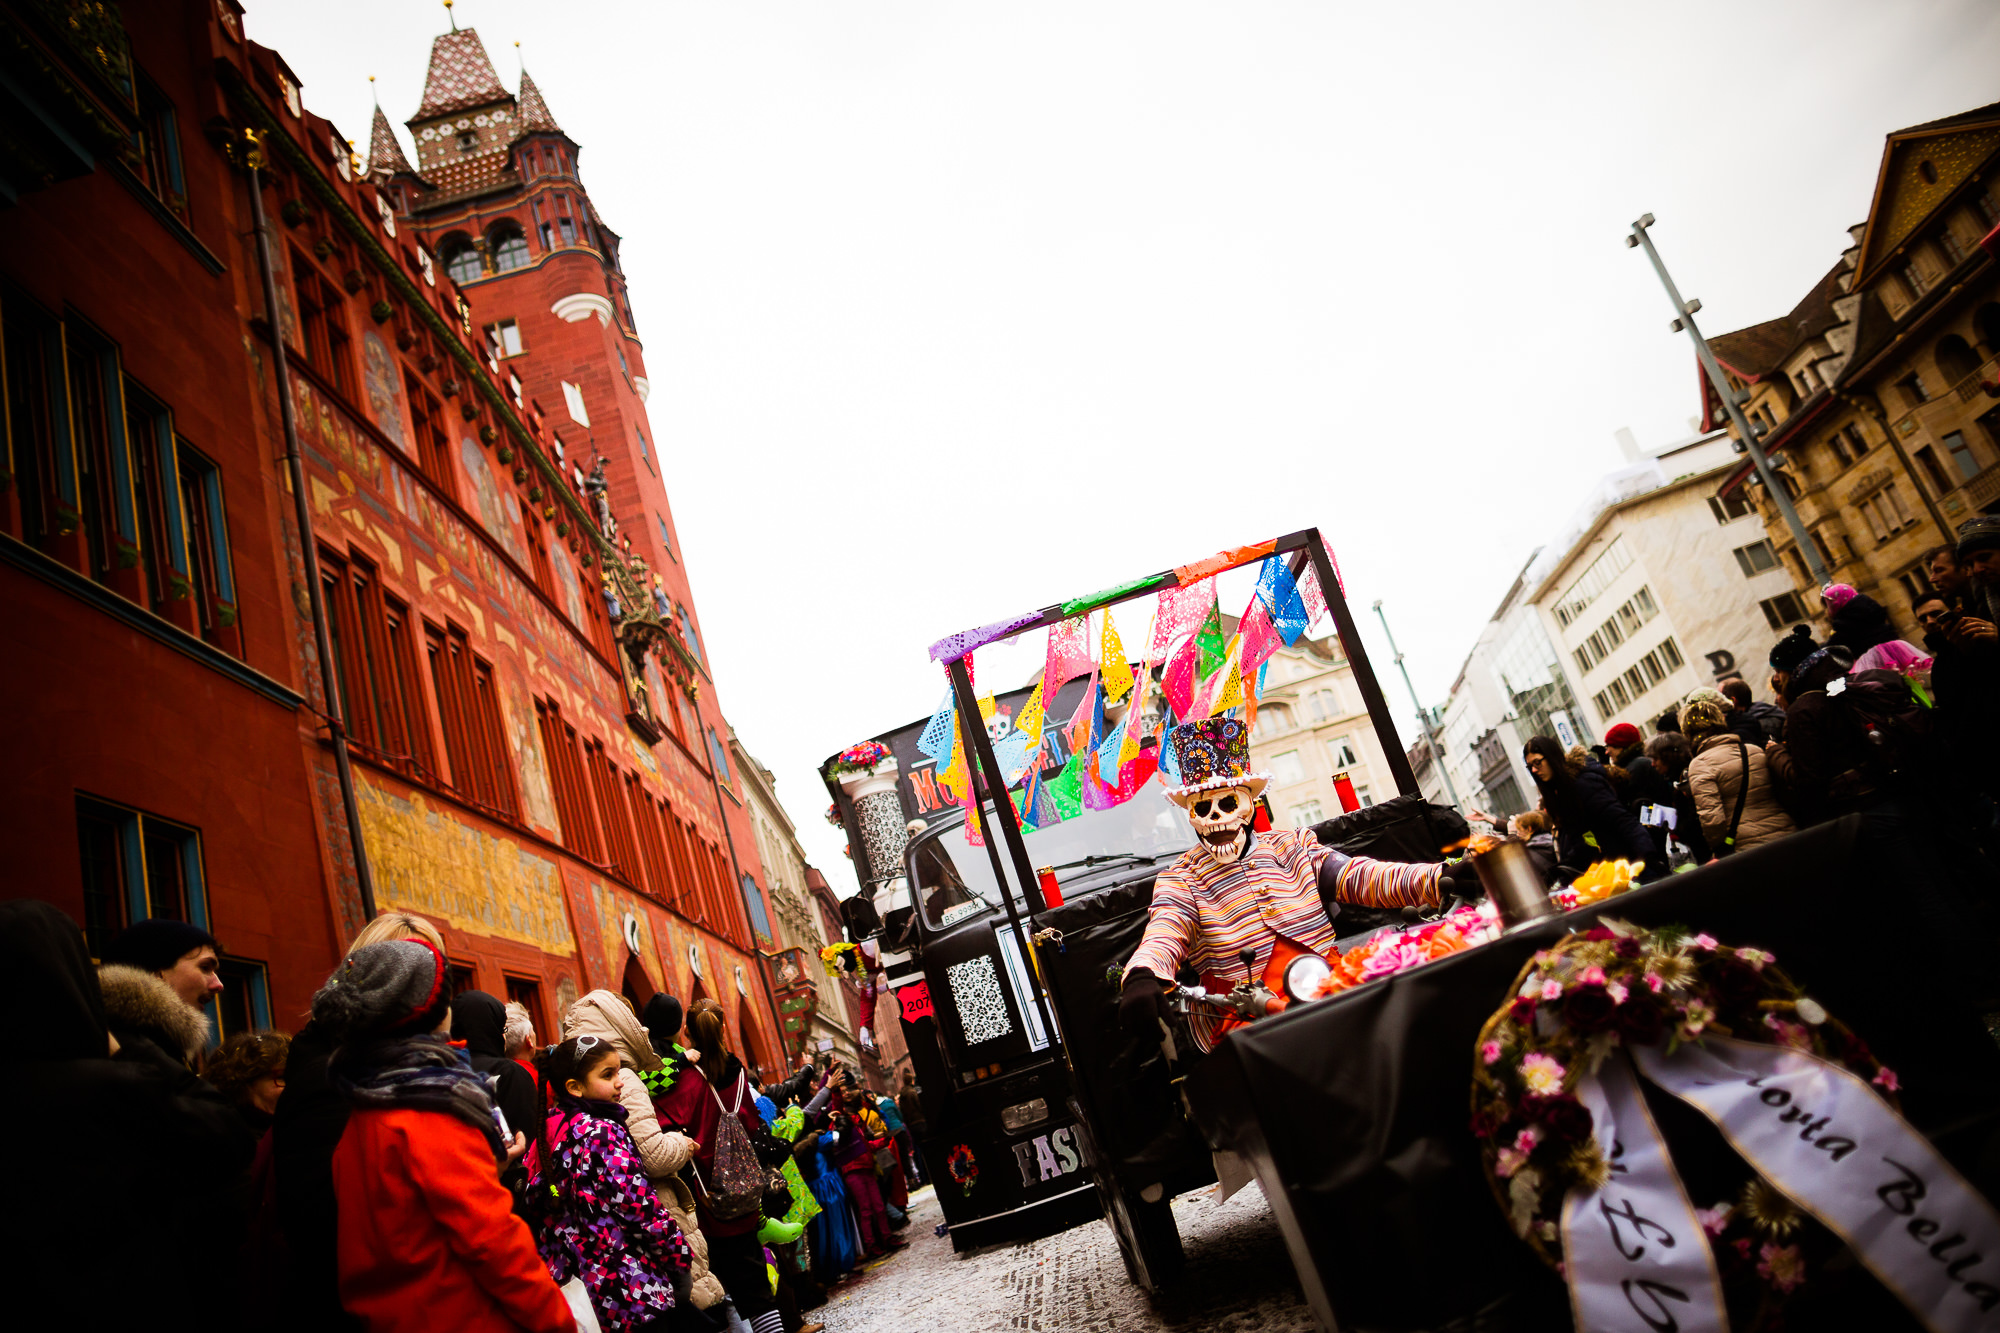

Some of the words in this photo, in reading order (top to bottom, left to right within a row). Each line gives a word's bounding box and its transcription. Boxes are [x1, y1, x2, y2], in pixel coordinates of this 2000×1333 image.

[906, 995, 930, 1013] 207
[1746, 1076, 1857, 1162] orta
[1877, 1156, 2000, 1313] Bella
